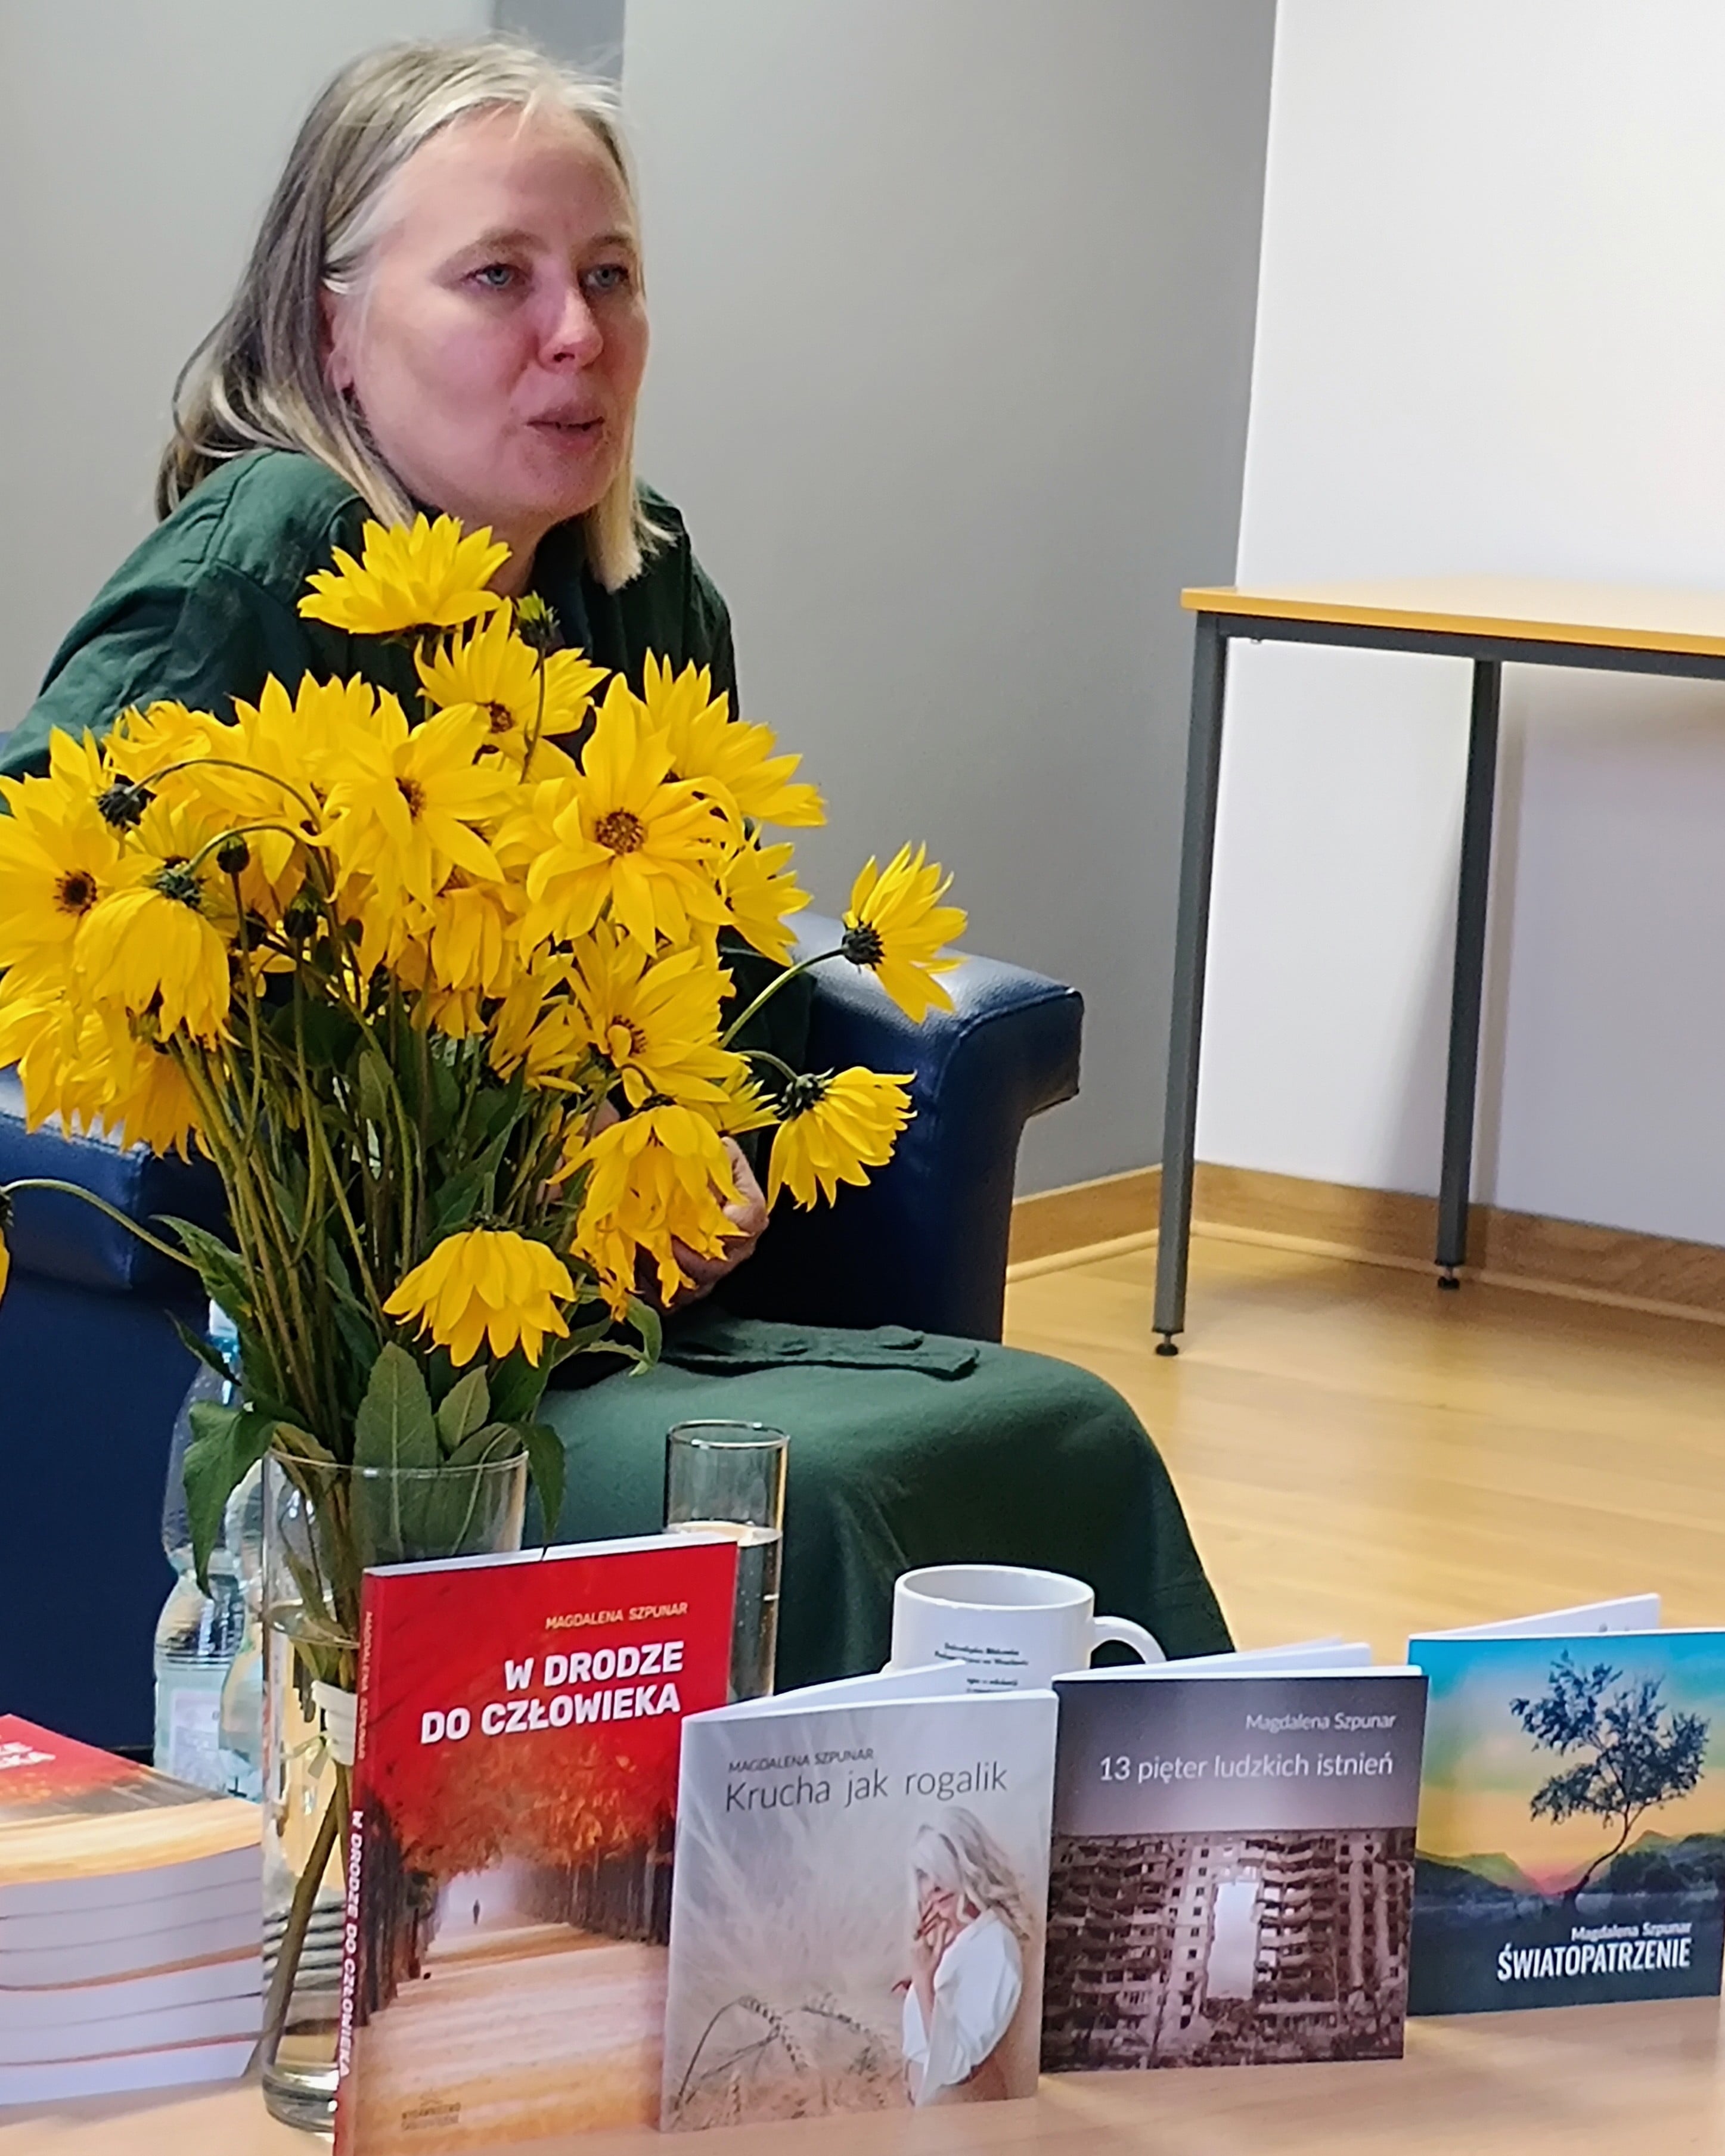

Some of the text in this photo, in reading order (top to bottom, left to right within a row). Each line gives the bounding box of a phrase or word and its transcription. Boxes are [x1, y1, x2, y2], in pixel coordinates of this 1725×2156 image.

[545, 1602, 688, 1629] MAGDALENA SZPUNAR
[504, 1641, 684, 1692] W DRODZE
[420, 1682, 681, 1744] DO CZŁOWIEKA
[1245, 1712, 1396, 1734] Magdalena Szpunar
[728, 1747, 874, 1773] MAGDALENA SZPUNAR
[1100, 1751, 1393, 1784] 13 pięter ludzkich istnień
[725, 1761, 1008, 1812] Krucha jak rogalik
[339, 1810, 364, 2077] W DRODZE DO CZŁOWIEKA
[1571, 1921, 1692, 1941] Magdalena Szpunar
[1497, 1937, 1692, 1981] ŚWIATOPATRZENIE
